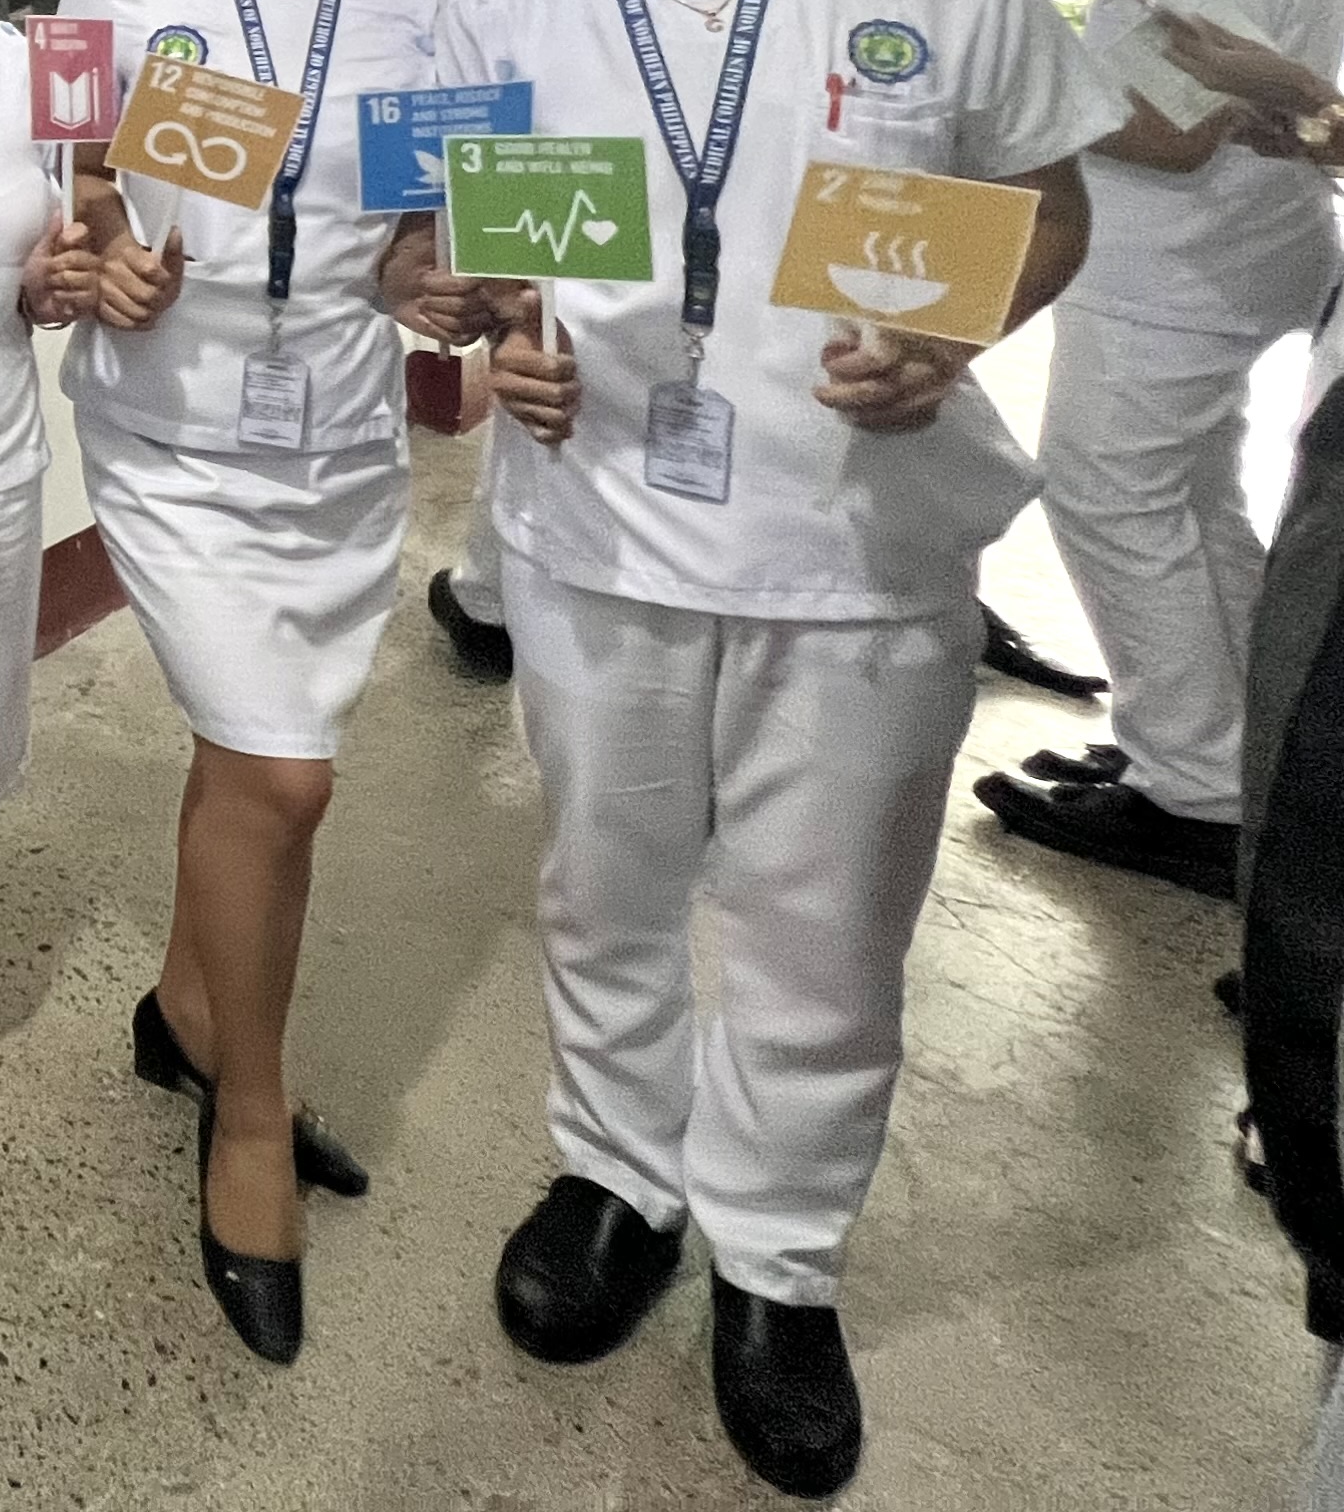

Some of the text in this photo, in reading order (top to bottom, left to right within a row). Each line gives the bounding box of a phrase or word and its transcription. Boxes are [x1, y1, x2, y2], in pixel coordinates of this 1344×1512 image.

[241, 6, 257, 23] OF
[34, 21, 47, 50] 4
[730, 36, 752, 55] OF
[308, 49, 325, 67] OF
[149, 62, 183, 93] 12
[713, 52, 749, 126] COLLEGES
[366, 95, 402, 125] 16
[628, 16, 670, 92] NORTHERN
[655, 91, 701, 182] PHILIPPINES
[461, 142, 483, 174] 3
[699, 124, 731, 188] MEDICAL
[816, 169, 848, 204] 2
